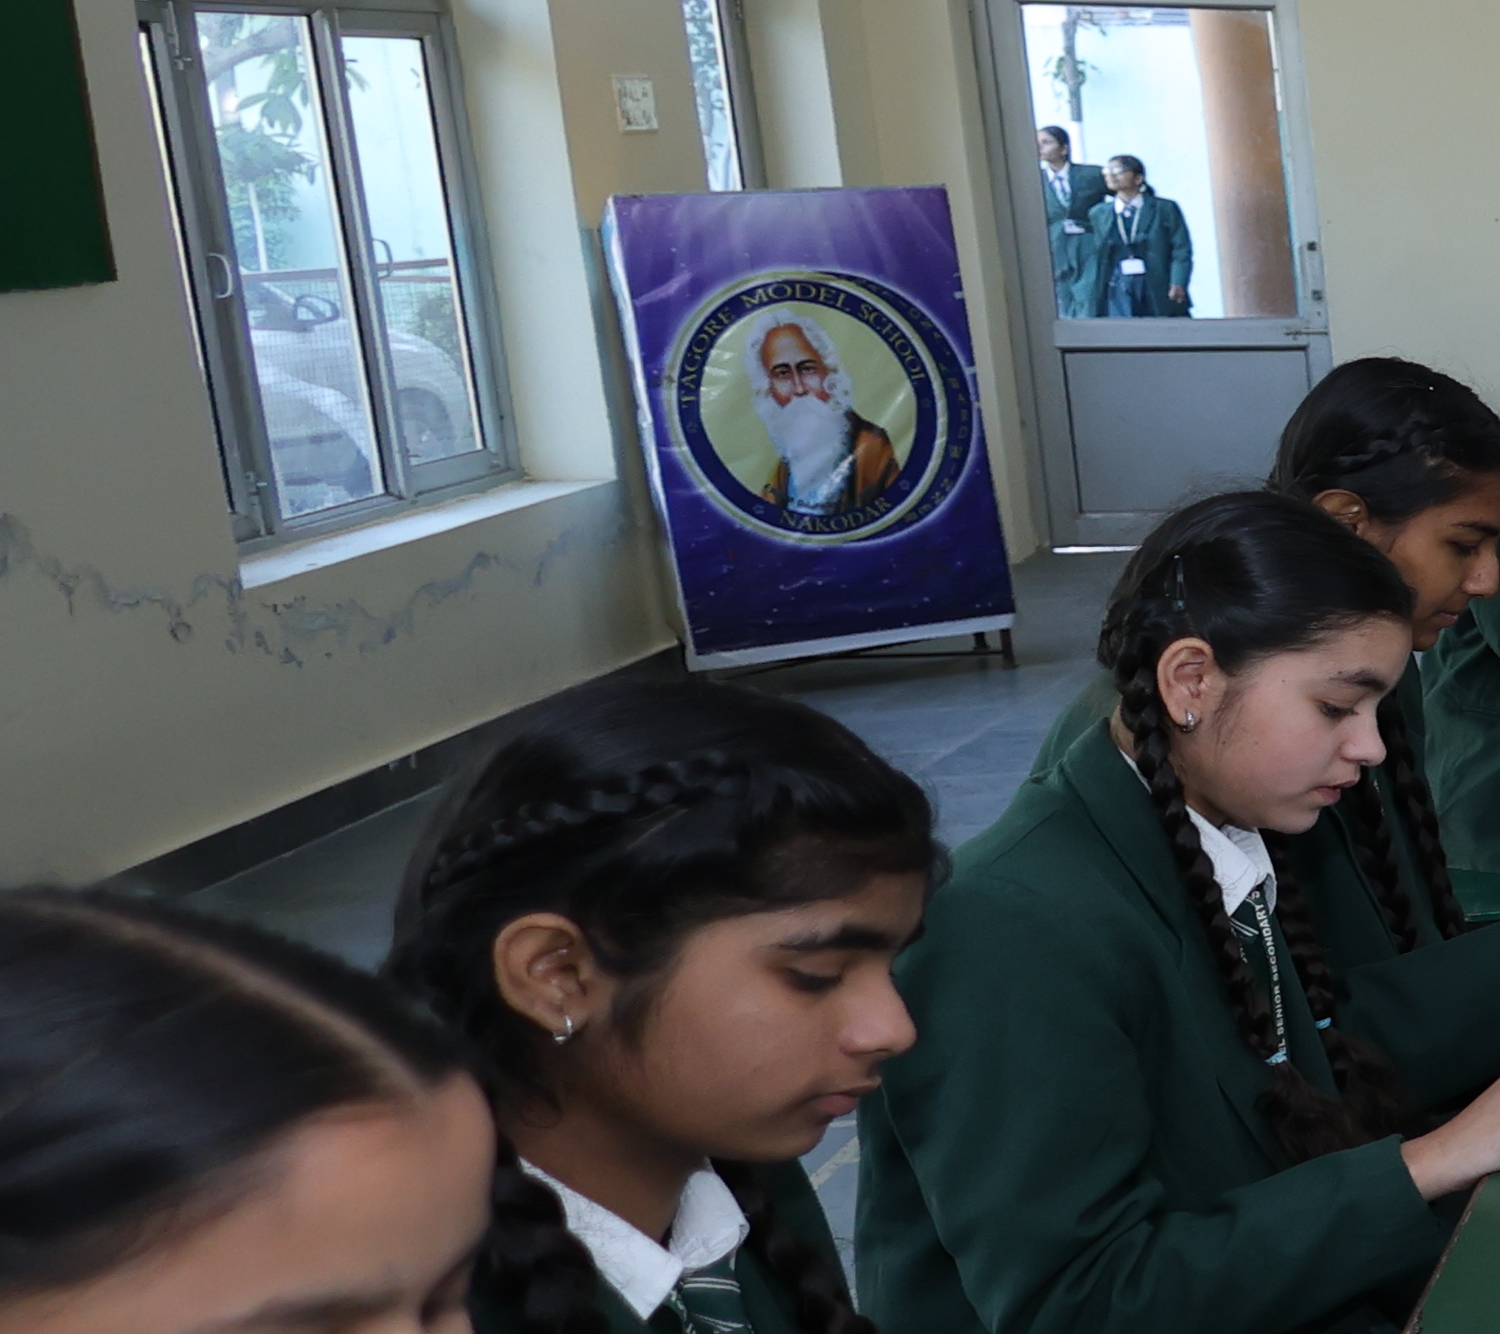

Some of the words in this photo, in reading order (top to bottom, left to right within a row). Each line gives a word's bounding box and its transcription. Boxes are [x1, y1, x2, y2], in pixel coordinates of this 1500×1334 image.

[681, 307, 737, 410] TAGORE
[740, 283, 852, 314] MODEL
[858, 302, 928, 387] SCHOOL
[779, 497, 893, 534] NAKODAR
[1256, 904, 1279, 982] SECONDARY
[1273, 985, 1285, 1036] SENIOR
